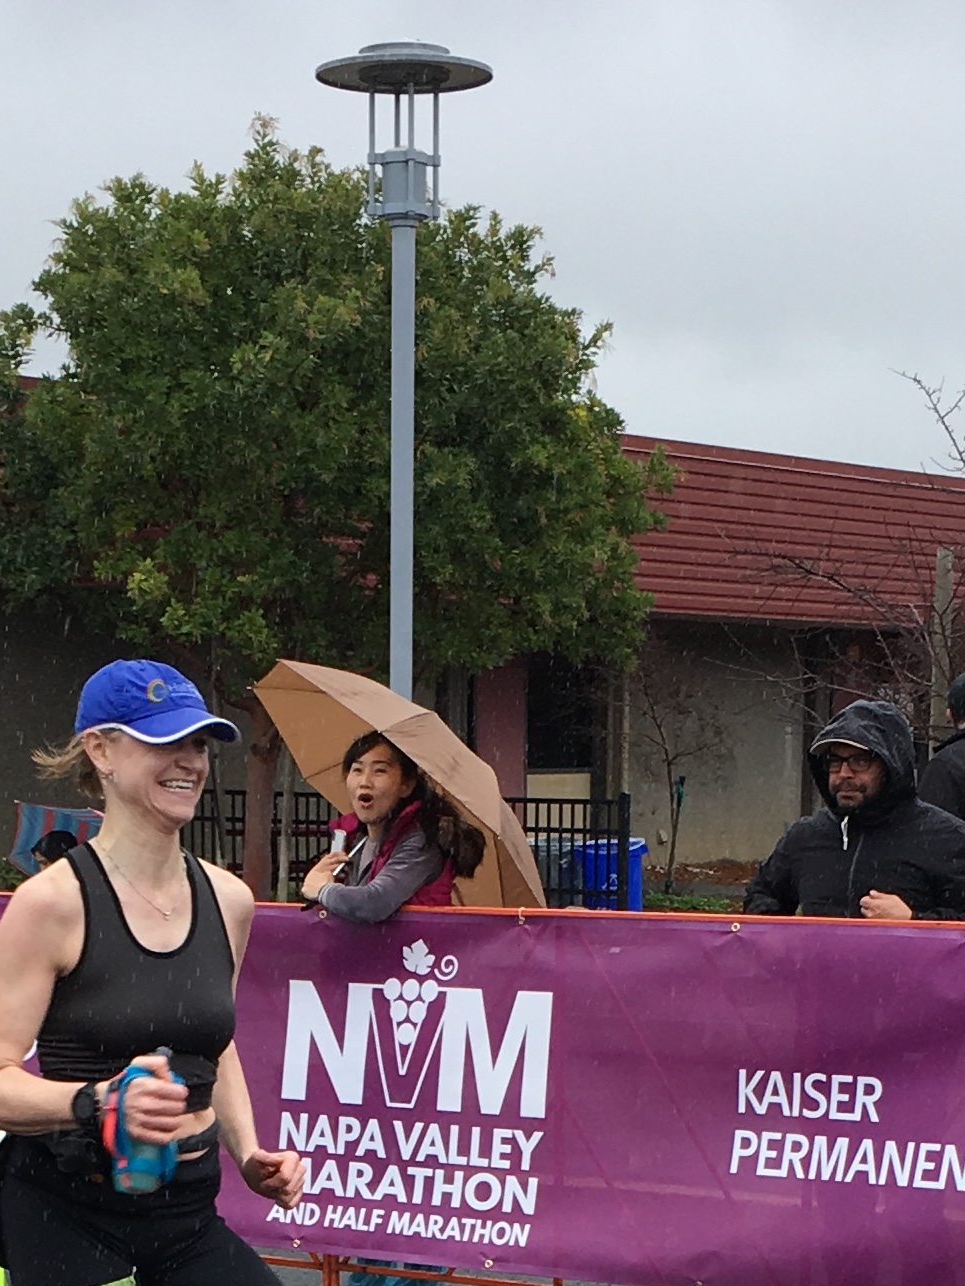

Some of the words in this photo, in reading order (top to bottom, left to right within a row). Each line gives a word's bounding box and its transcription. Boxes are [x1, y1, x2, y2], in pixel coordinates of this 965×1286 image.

[737, 1068, 884, 1123] KAISER
[278, 1111, 386, 1159] NAPA
[392, 1120, 544, 1171] VALLEY
[266, 1202, 320, 1226] AND
[323, 1204, 384, 1232] HALF
[386, 1210, 531, 1247] MARATHON
